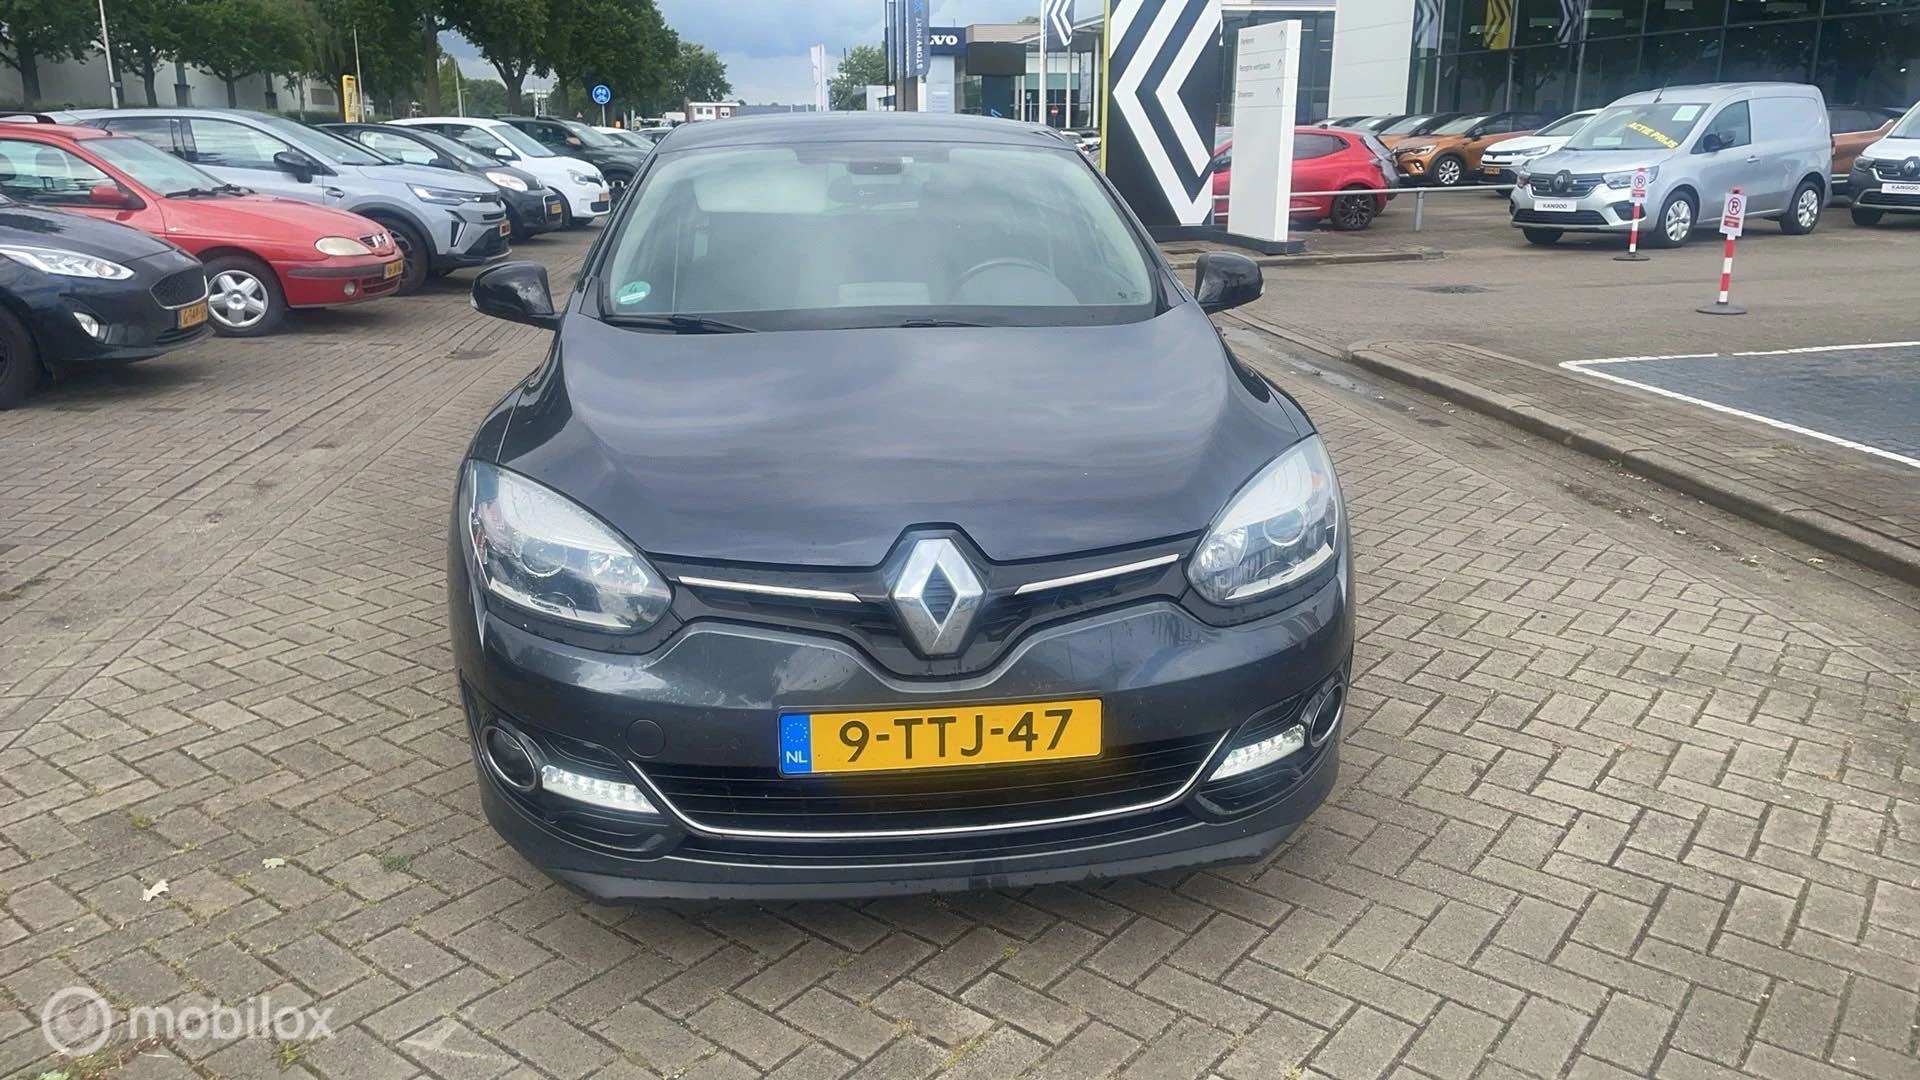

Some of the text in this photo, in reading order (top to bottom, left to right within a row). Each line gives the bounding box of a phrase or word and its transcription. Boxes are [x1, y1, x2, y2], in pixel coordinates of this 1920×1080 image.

[930, 35, 958, 45] VO
[916, 40, 924, 69] STORY
[1627, 122, 1679, 149] ACTIE PRIJS
[839, 708, 1073, 763] 9-TTJ-47
[786, 751, 807, 763] NL
